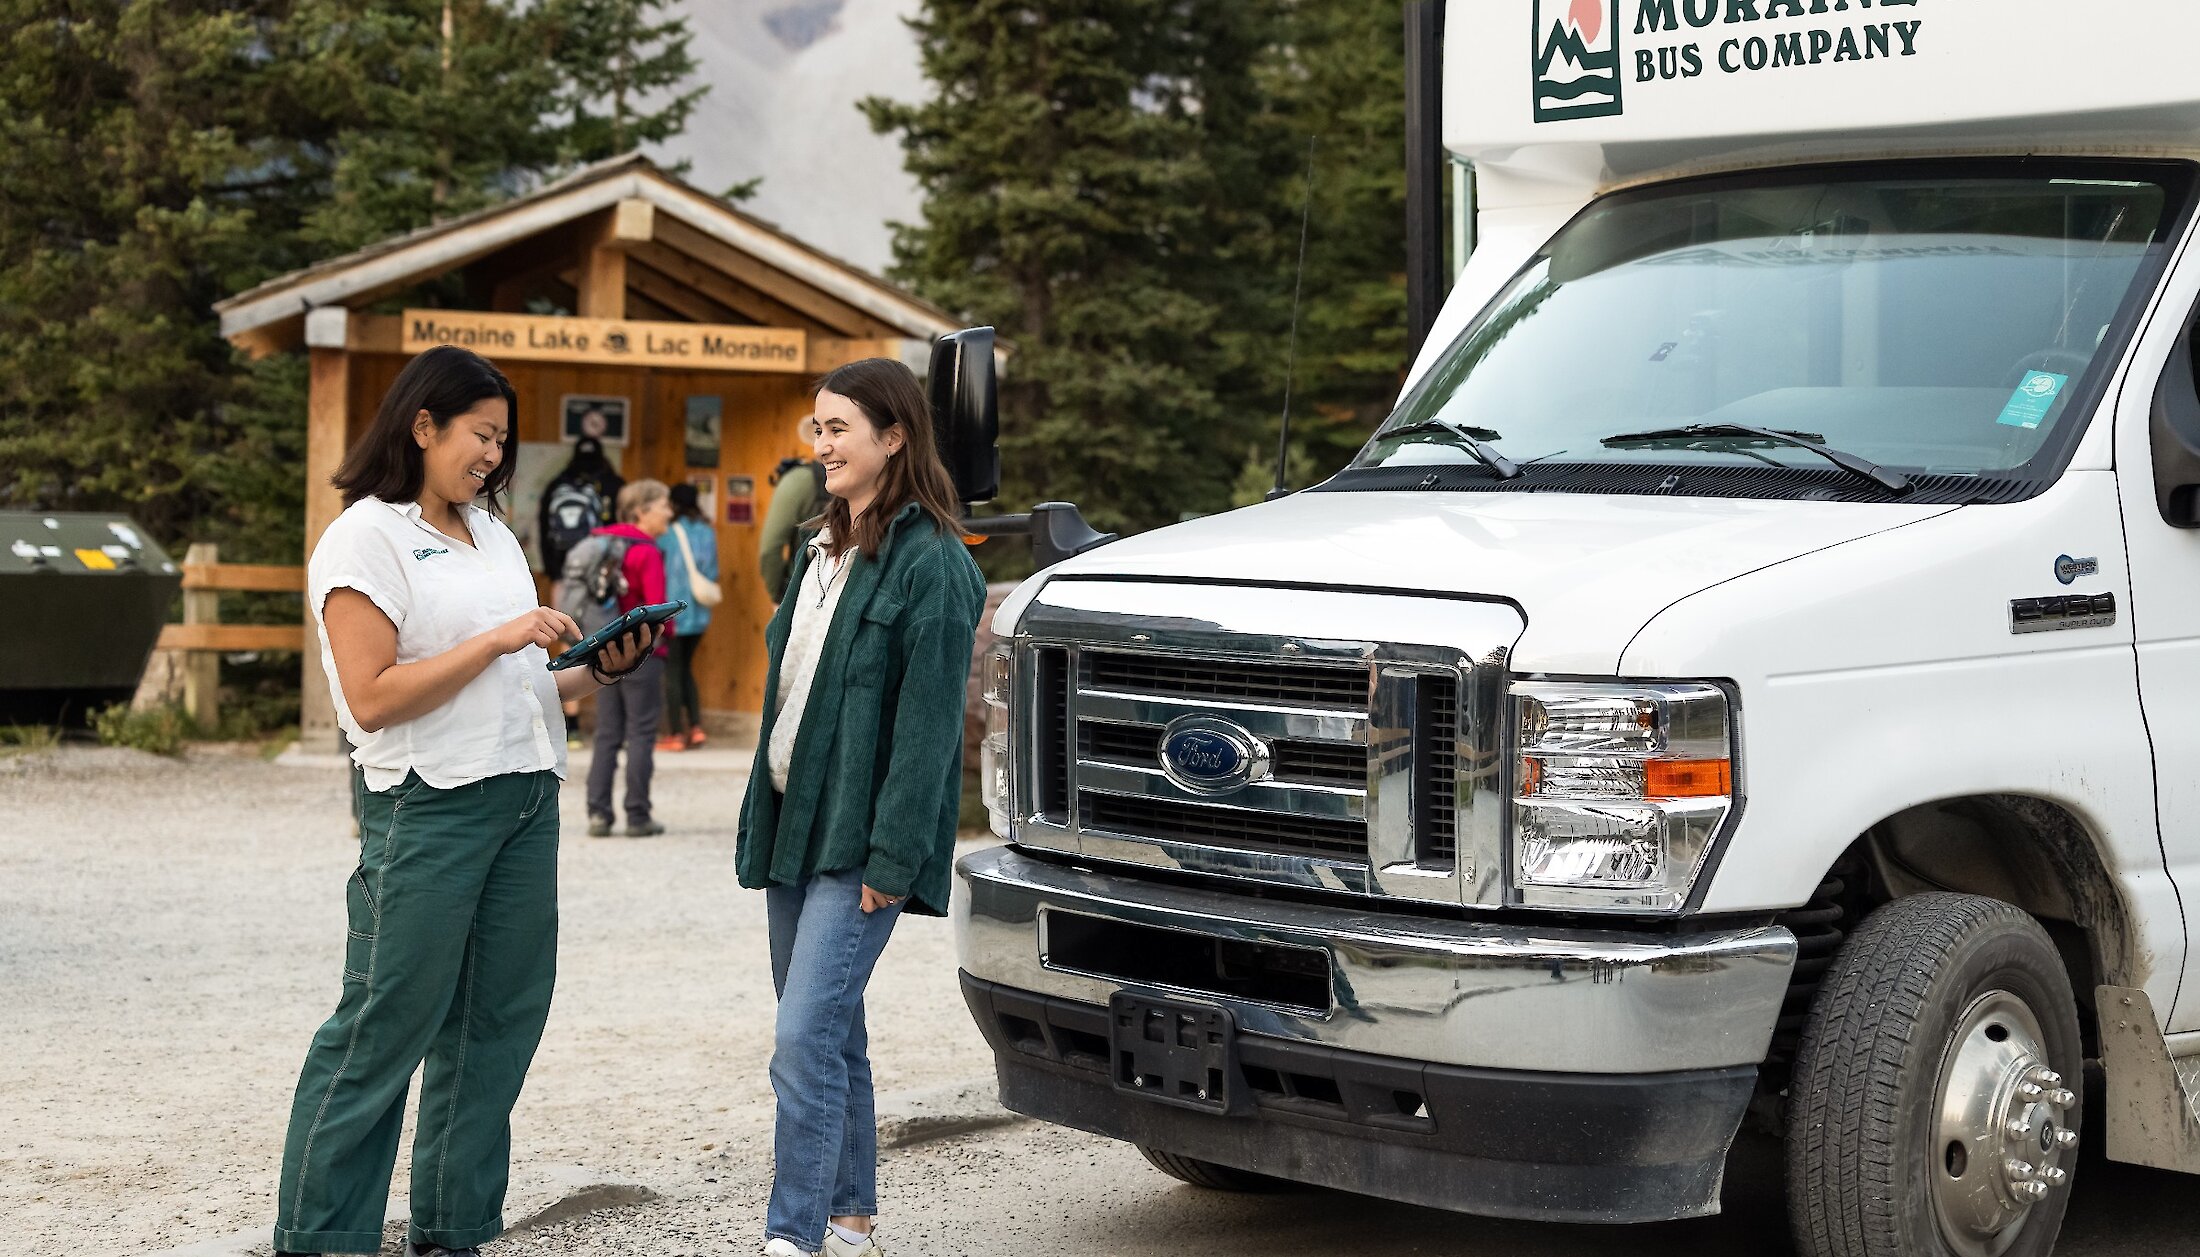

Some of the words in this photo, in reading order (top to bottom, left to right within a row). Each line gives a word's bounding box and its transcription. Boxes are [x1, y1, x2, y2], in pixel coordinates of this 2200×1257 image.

[1635, 43, 1703, 82] BUS
[1718, 20, 1922, 73] COMPANY
[412, 319, 516, 348] Moraine
[528, 325, 590, 351] Lake
[646, 331, 690, 356] Lac
[702, 334, 797, 361] Moraine
[1178, 736, 1224, 769] Ford
